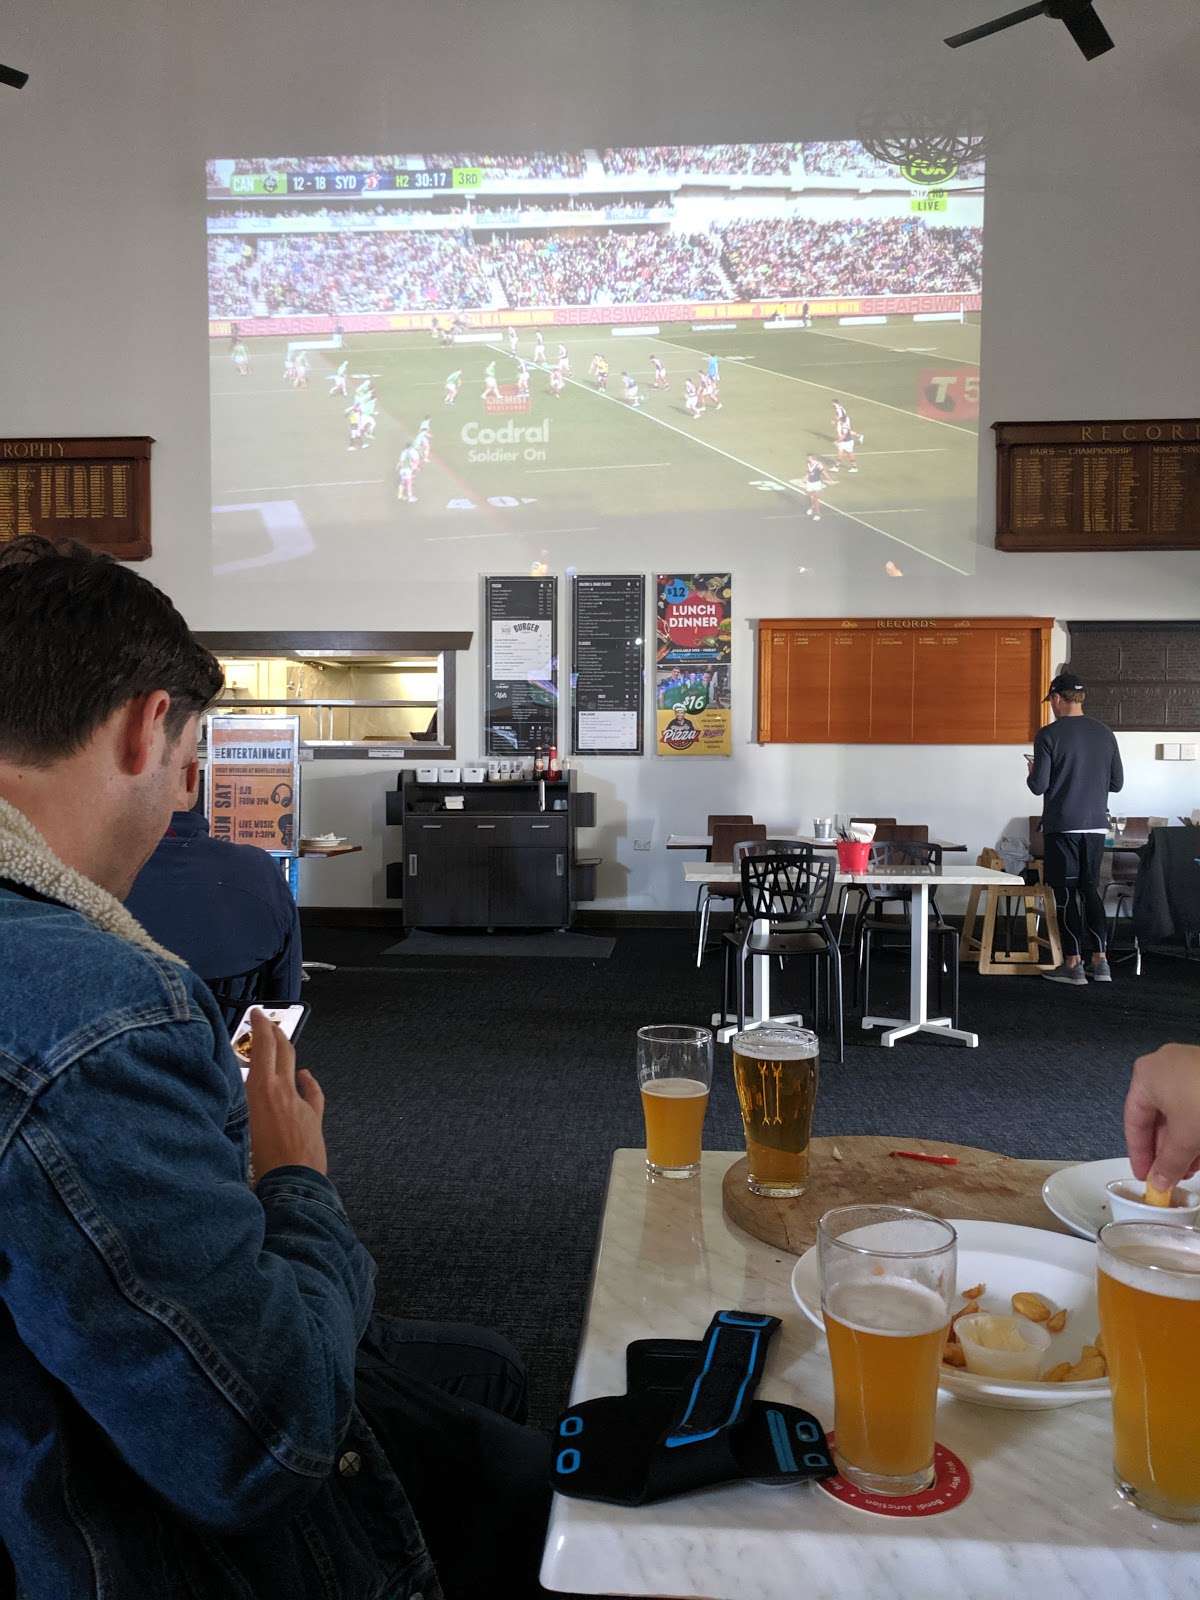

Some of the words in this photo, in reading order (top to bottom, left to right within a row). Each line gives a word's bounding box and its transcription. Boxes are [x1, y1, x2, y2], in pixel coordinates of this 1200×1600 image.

[233, 177, 254, 192] CAN
[293, 177, 304, 191] 12
[315, 176, 326, 190] 18
[336, 176, 356, 190] SYD
[396, 174, 409, 188] H2
[415, 173, 446, 187] 30:17
[458, 172, 478, 185] 3RD
[917, 201, 939, 211] LIVE
[863, 298, 933, 313] SEEARS
[557, 308, 625, 323] SEEARS
[626, 305, 690, 320] WORKWEAR
[931, 376, 958, 403] T
[461, 418, 549, 445] Codral
[4, 443, 65, 457] ROPHY
[468, 447, 519, 463] Soldier
[524, 448, 546, 461] On
[1069, 447, 1132, 455] CHAMPIONSHIP
[667, 588, 685, 597] $12
[672, 604, 716, 616] LUNCH
[513, 622, 540, 633] BURGER
[669, 617, 718, 628] DINNER
[877, 620, 937, 628] RECORDS
[683, 696, 704, 710] $16
[663, 729, 698, 743] Pizza
[221, 747, 292, 760] ENTERTAINMENT
[215, 783, 232, 808] SAT
[214, 816, 231, 842] SUN
[239, 820, 252, 828] LIVE
[254, 820, 274, 828] MUSIC
[865, 1499, 912, 1511] Junction
[916, 1499, 944, 1511] Bondi
